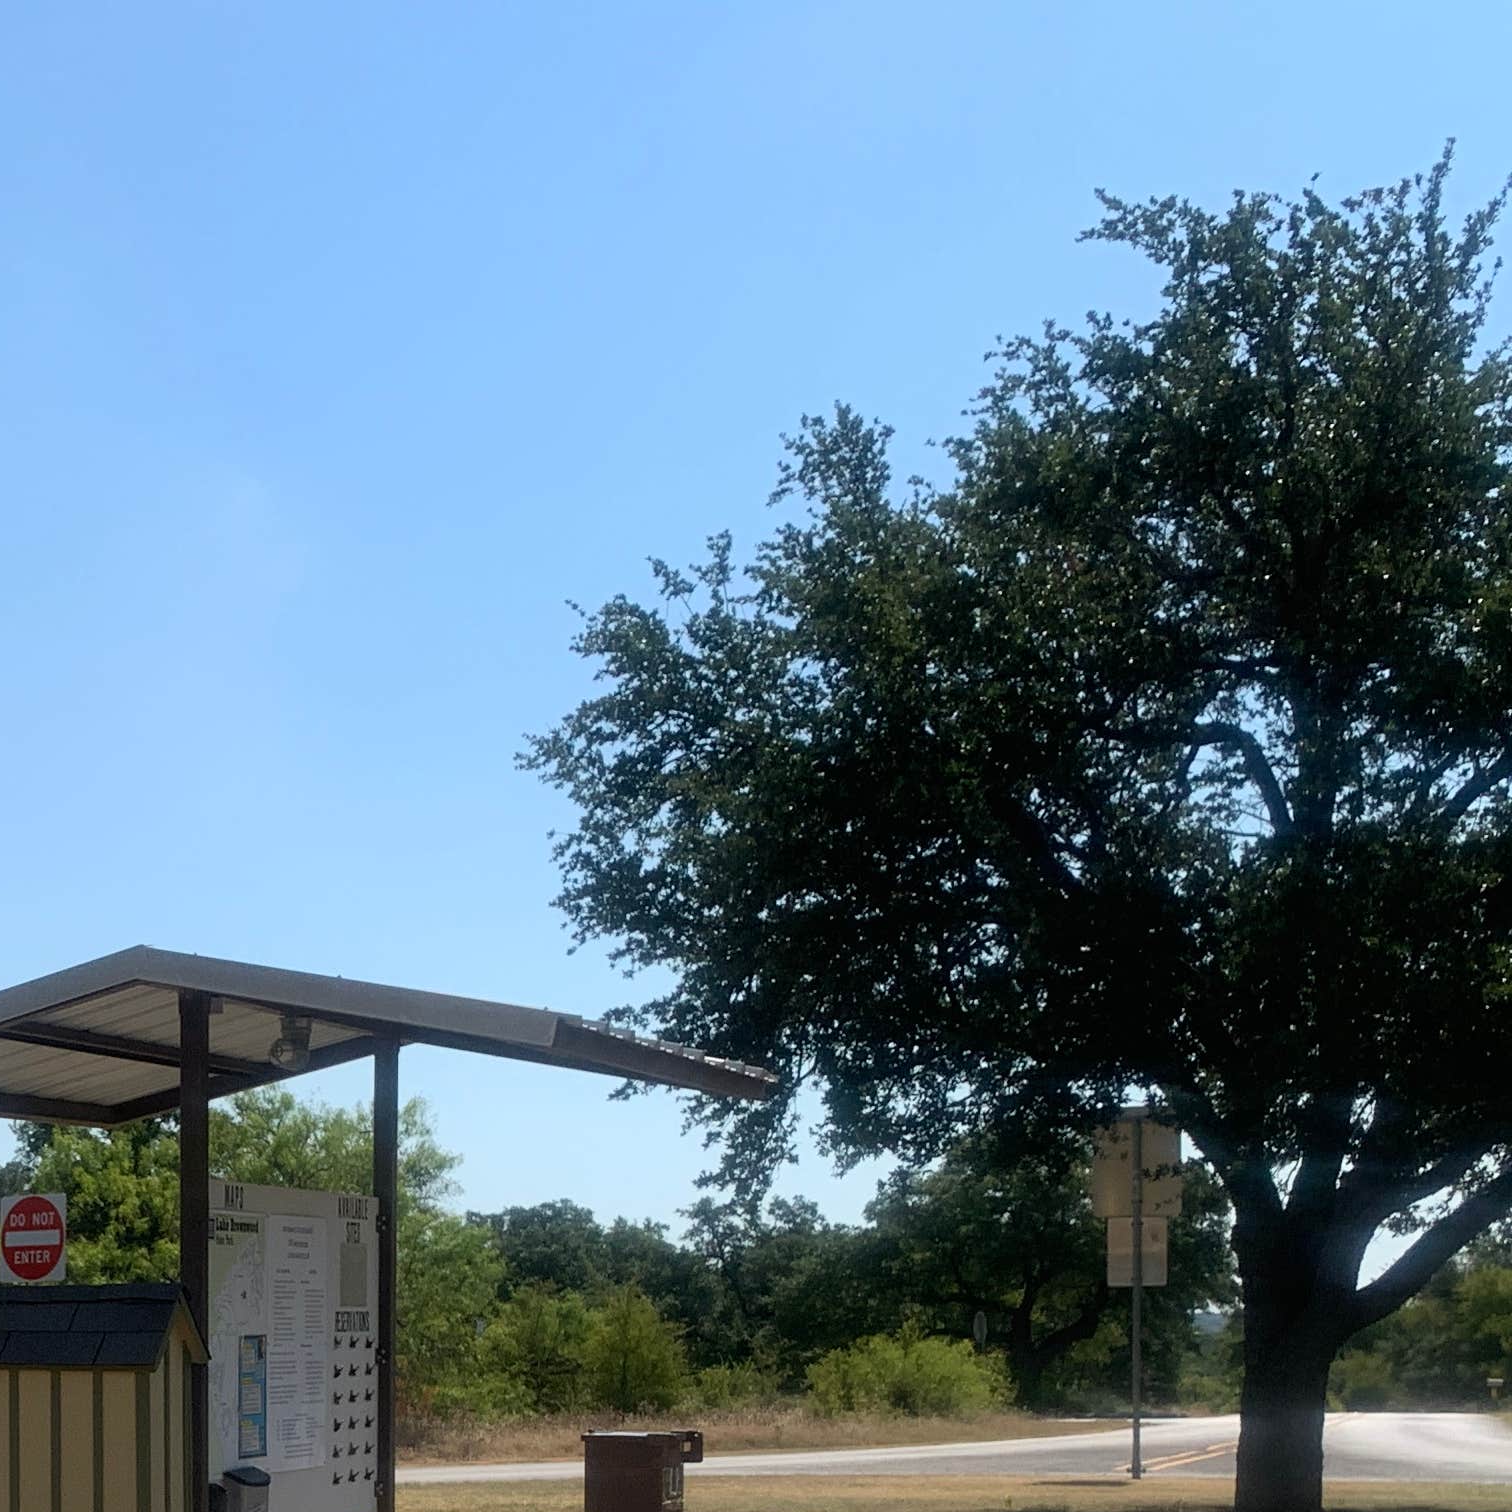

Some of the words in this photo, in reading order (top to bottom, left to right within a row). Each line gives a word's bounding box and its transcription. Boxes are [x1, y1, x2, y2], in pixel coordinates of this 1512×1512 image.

[224, 1185, 244, 1209] MAPS
[10, 1213, 25, 1227] DO
[32, 1212, 55, 1225] NOT
[14, 1250, 50, 1264] ENTER
